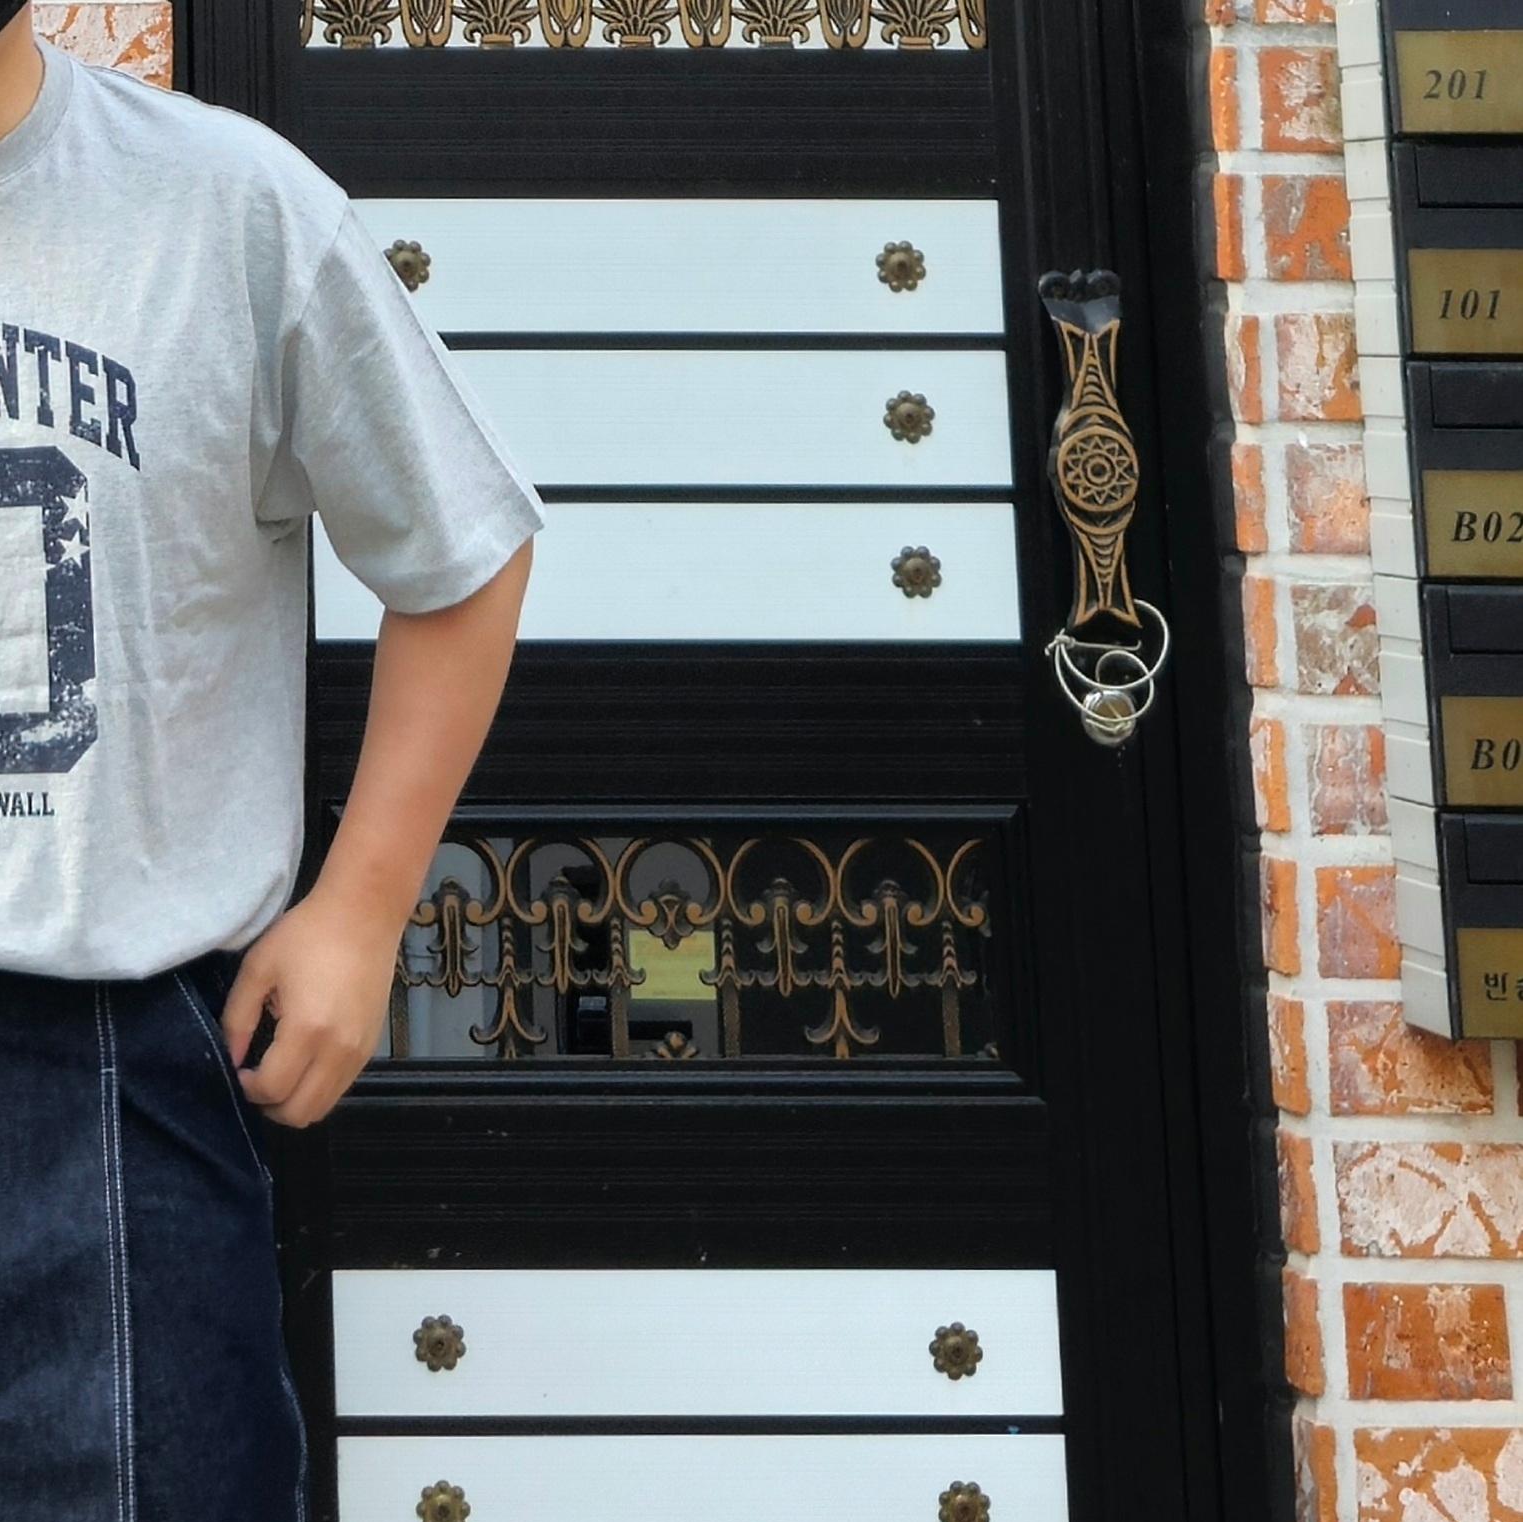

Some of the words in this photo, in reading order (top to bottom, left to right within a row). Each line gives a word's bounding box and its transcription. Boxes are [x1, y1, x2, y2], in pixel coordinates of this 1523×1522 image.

[1423, 69, 1487, 100] 201
[1438, 289, 1501, 320] 101
[1450, 510, 1523, 542] B02
[1470, 738, 1521, 770] B0
